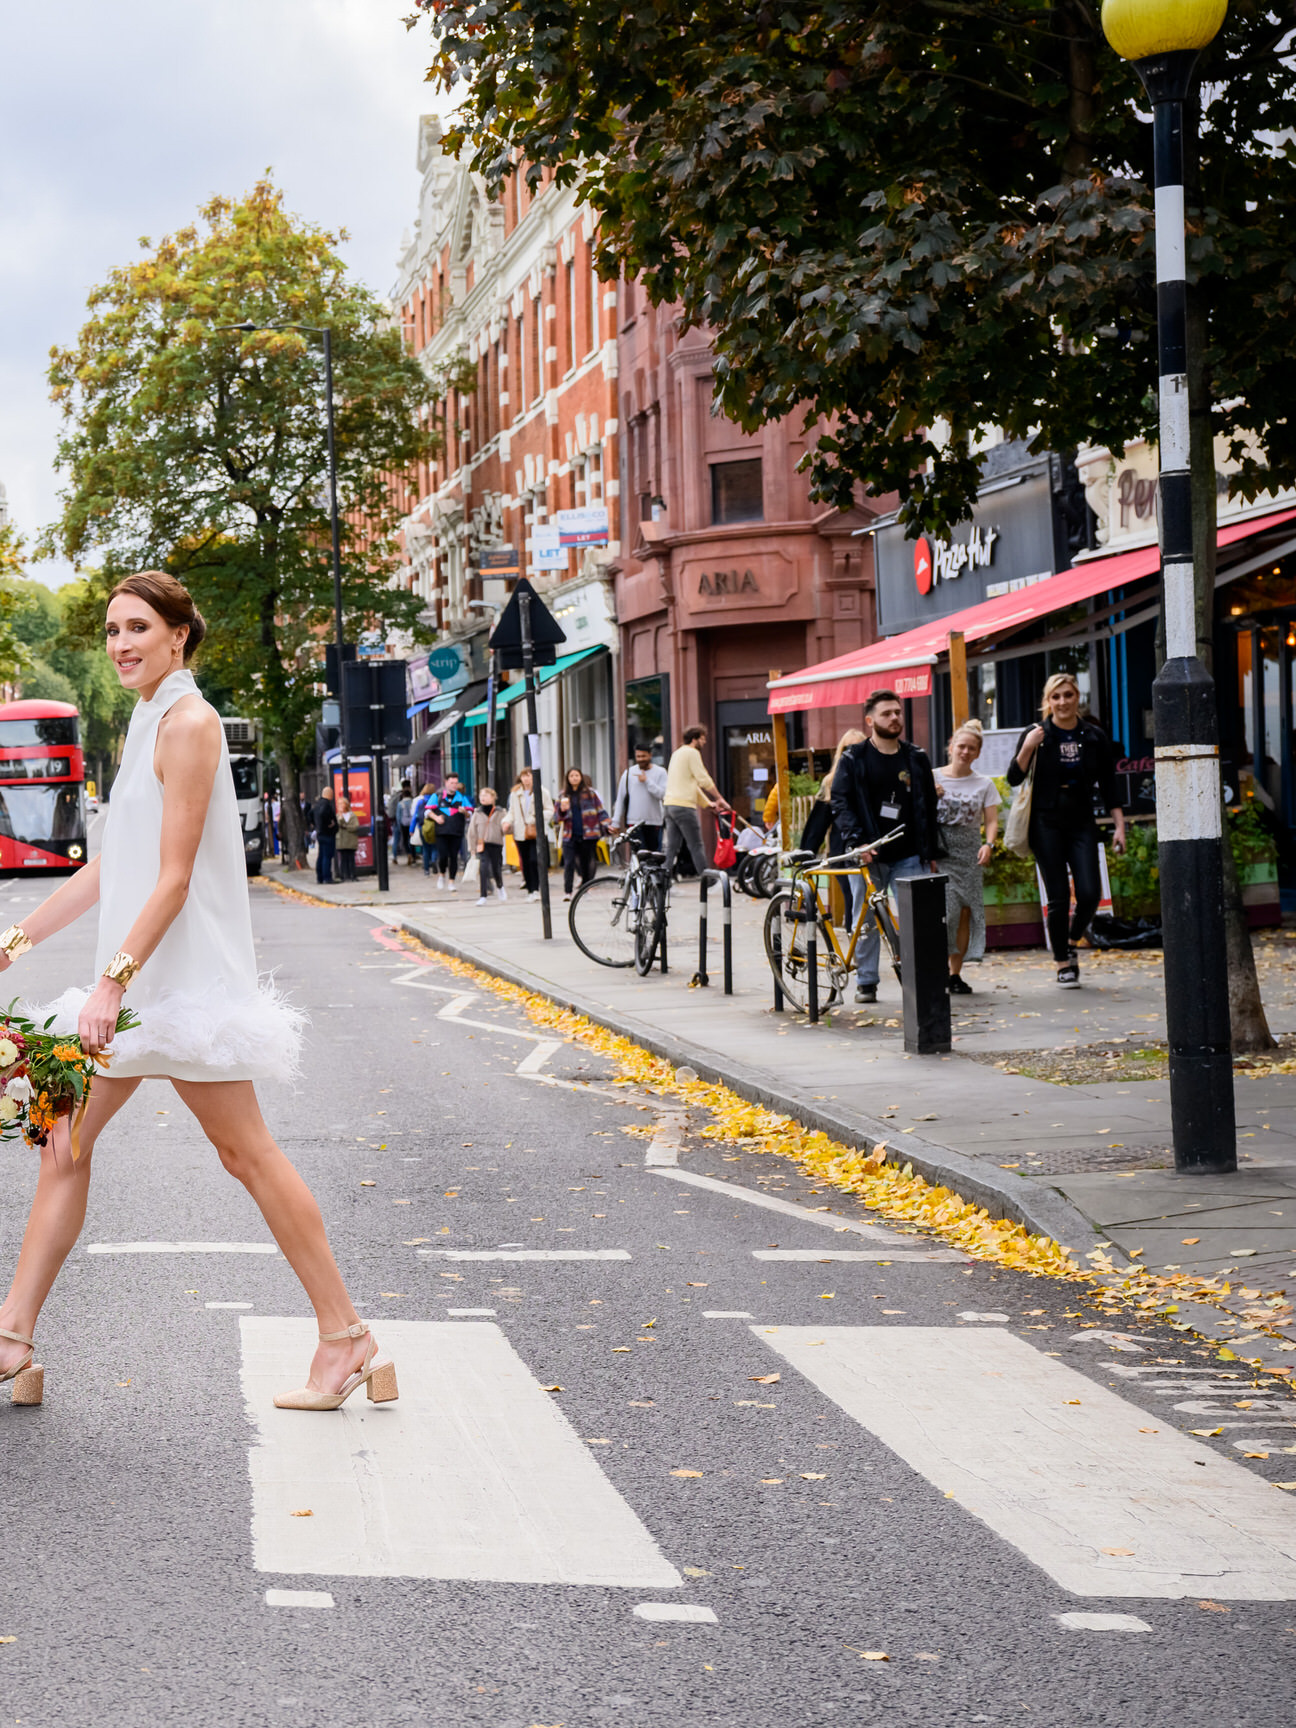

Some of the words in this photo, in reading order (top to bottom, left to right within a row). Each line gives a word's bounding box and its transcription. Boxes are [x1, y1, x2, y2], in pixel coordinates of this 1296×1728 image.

[576, 534, 590, 542] LET
[539, 549, 561, 558] LET
[933, 539, 967, 586] Pizza
[967, 526, 997, 571] Hut
[698, 568, 760, 596] ARIA
[430, 656, 457, 669] strip
[744, 732, 772, 744] ARIA
[50, 760, 62, 773] 19
